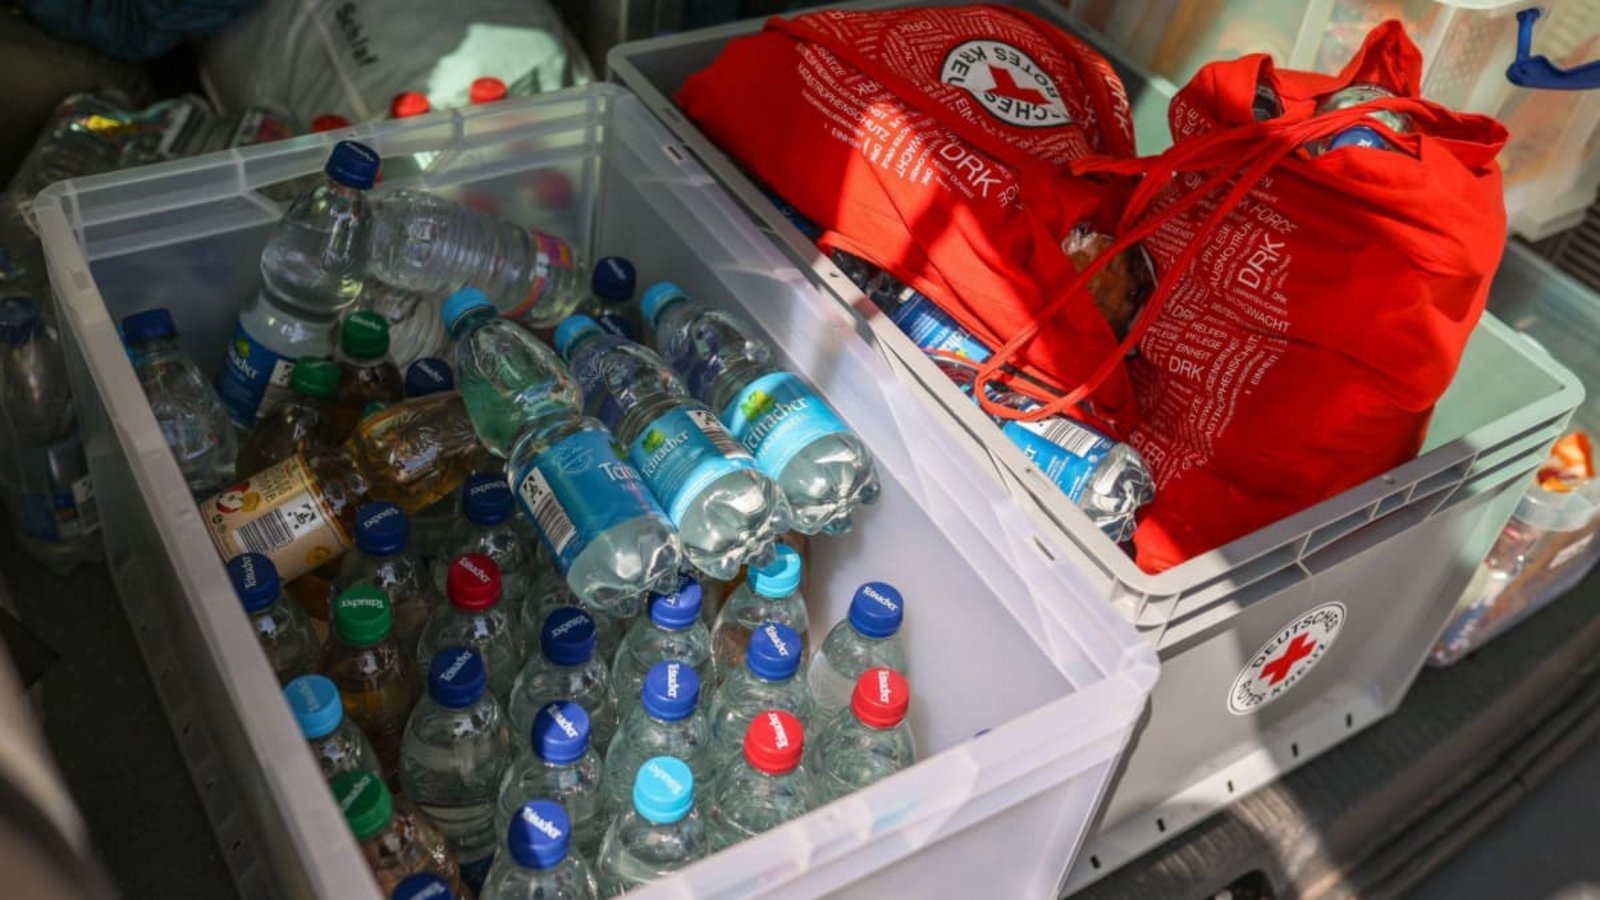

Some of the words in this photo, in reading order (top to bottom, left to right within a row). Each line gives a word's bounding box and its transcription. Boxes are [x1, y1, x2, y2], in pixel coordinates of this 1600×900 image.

[946, 46, 988, 86] KREU
[993, 45, 1059, 99] ROTES
[940, 143, 1003, 198] DRK
[1251, 202, 1298, 236] FORCE
[1237, 232, 1286, 290] DRK
[1168, 355, 1207, 382] DRK
[863, 586, 898, 611] Teinacher
[1250, 609, 1338, 669] DEUTSCHES
